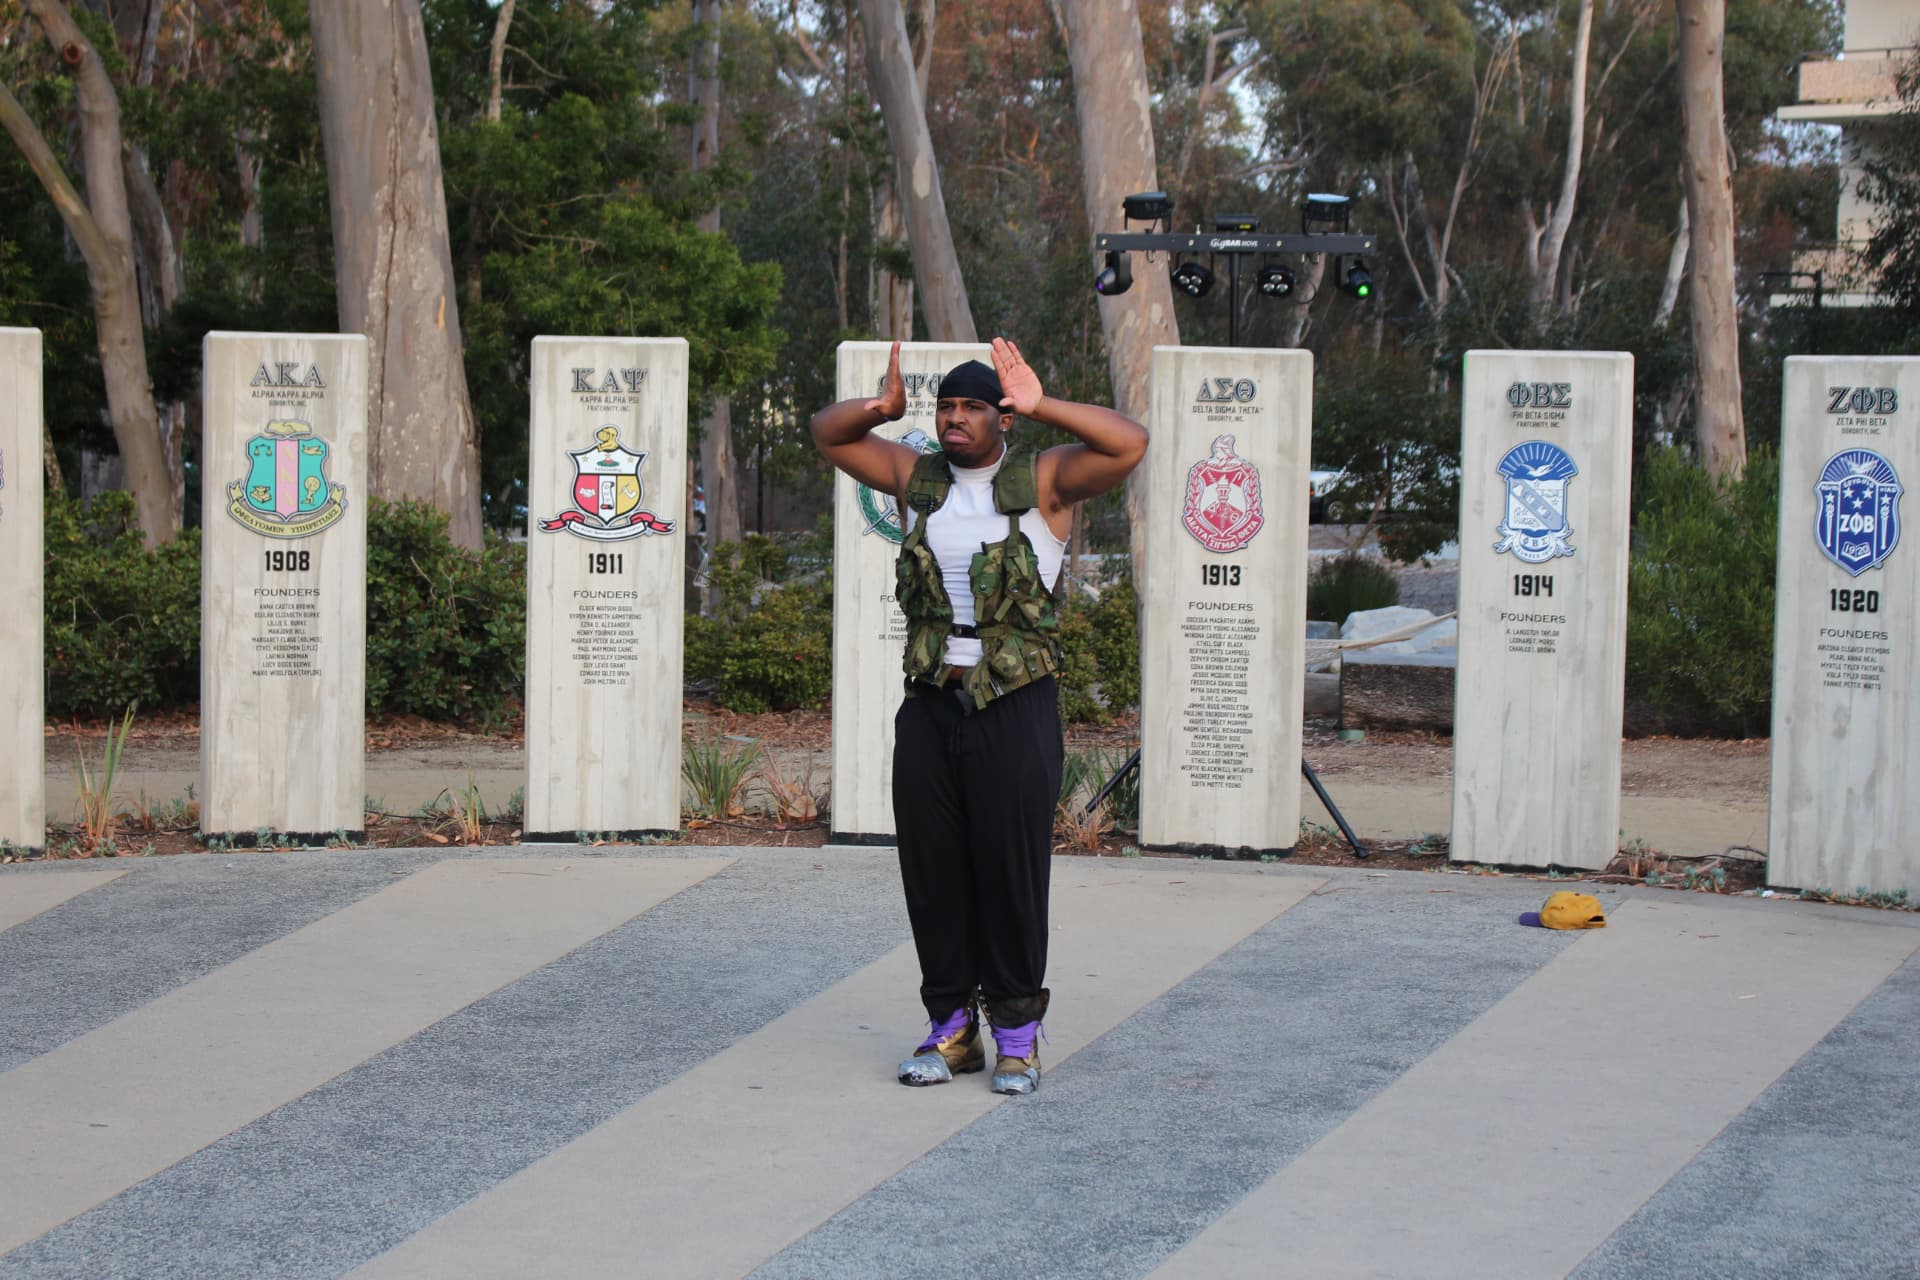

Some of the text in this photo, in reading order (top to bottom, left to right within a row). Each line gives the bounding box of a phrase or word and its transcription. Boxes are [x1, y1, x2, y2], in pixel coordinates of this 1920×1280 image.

[580, 395, 601, 403] KAPPA
[1192, 405, 1213, 413] DELTA
[1215, 406, 1236, 414] SIGMA
[1512, 411, 1523, 419] PHI
[1544, 412, 1565, 420] SIGMA
[1835, 417, 1887, 426] ZETA PHI BETA
[265, 550, 310, 571] 1908
[588, 553, 623, 574] 1911
[1202, 564, 1241, 587] 1913
[1514, 574, 1553, 597] 1914
[254, 588, 320, 597] FOUNDERS
[573, 590, 638, 599] FOUNDERS
[1830, 588, 1879, 613] 1920
[1188, 601, 1254, 611] FOUNDERS
[1500, 612, 1566, 623] FOUNDERS
[1820, 628, 1889, 640] FOUNDERS
